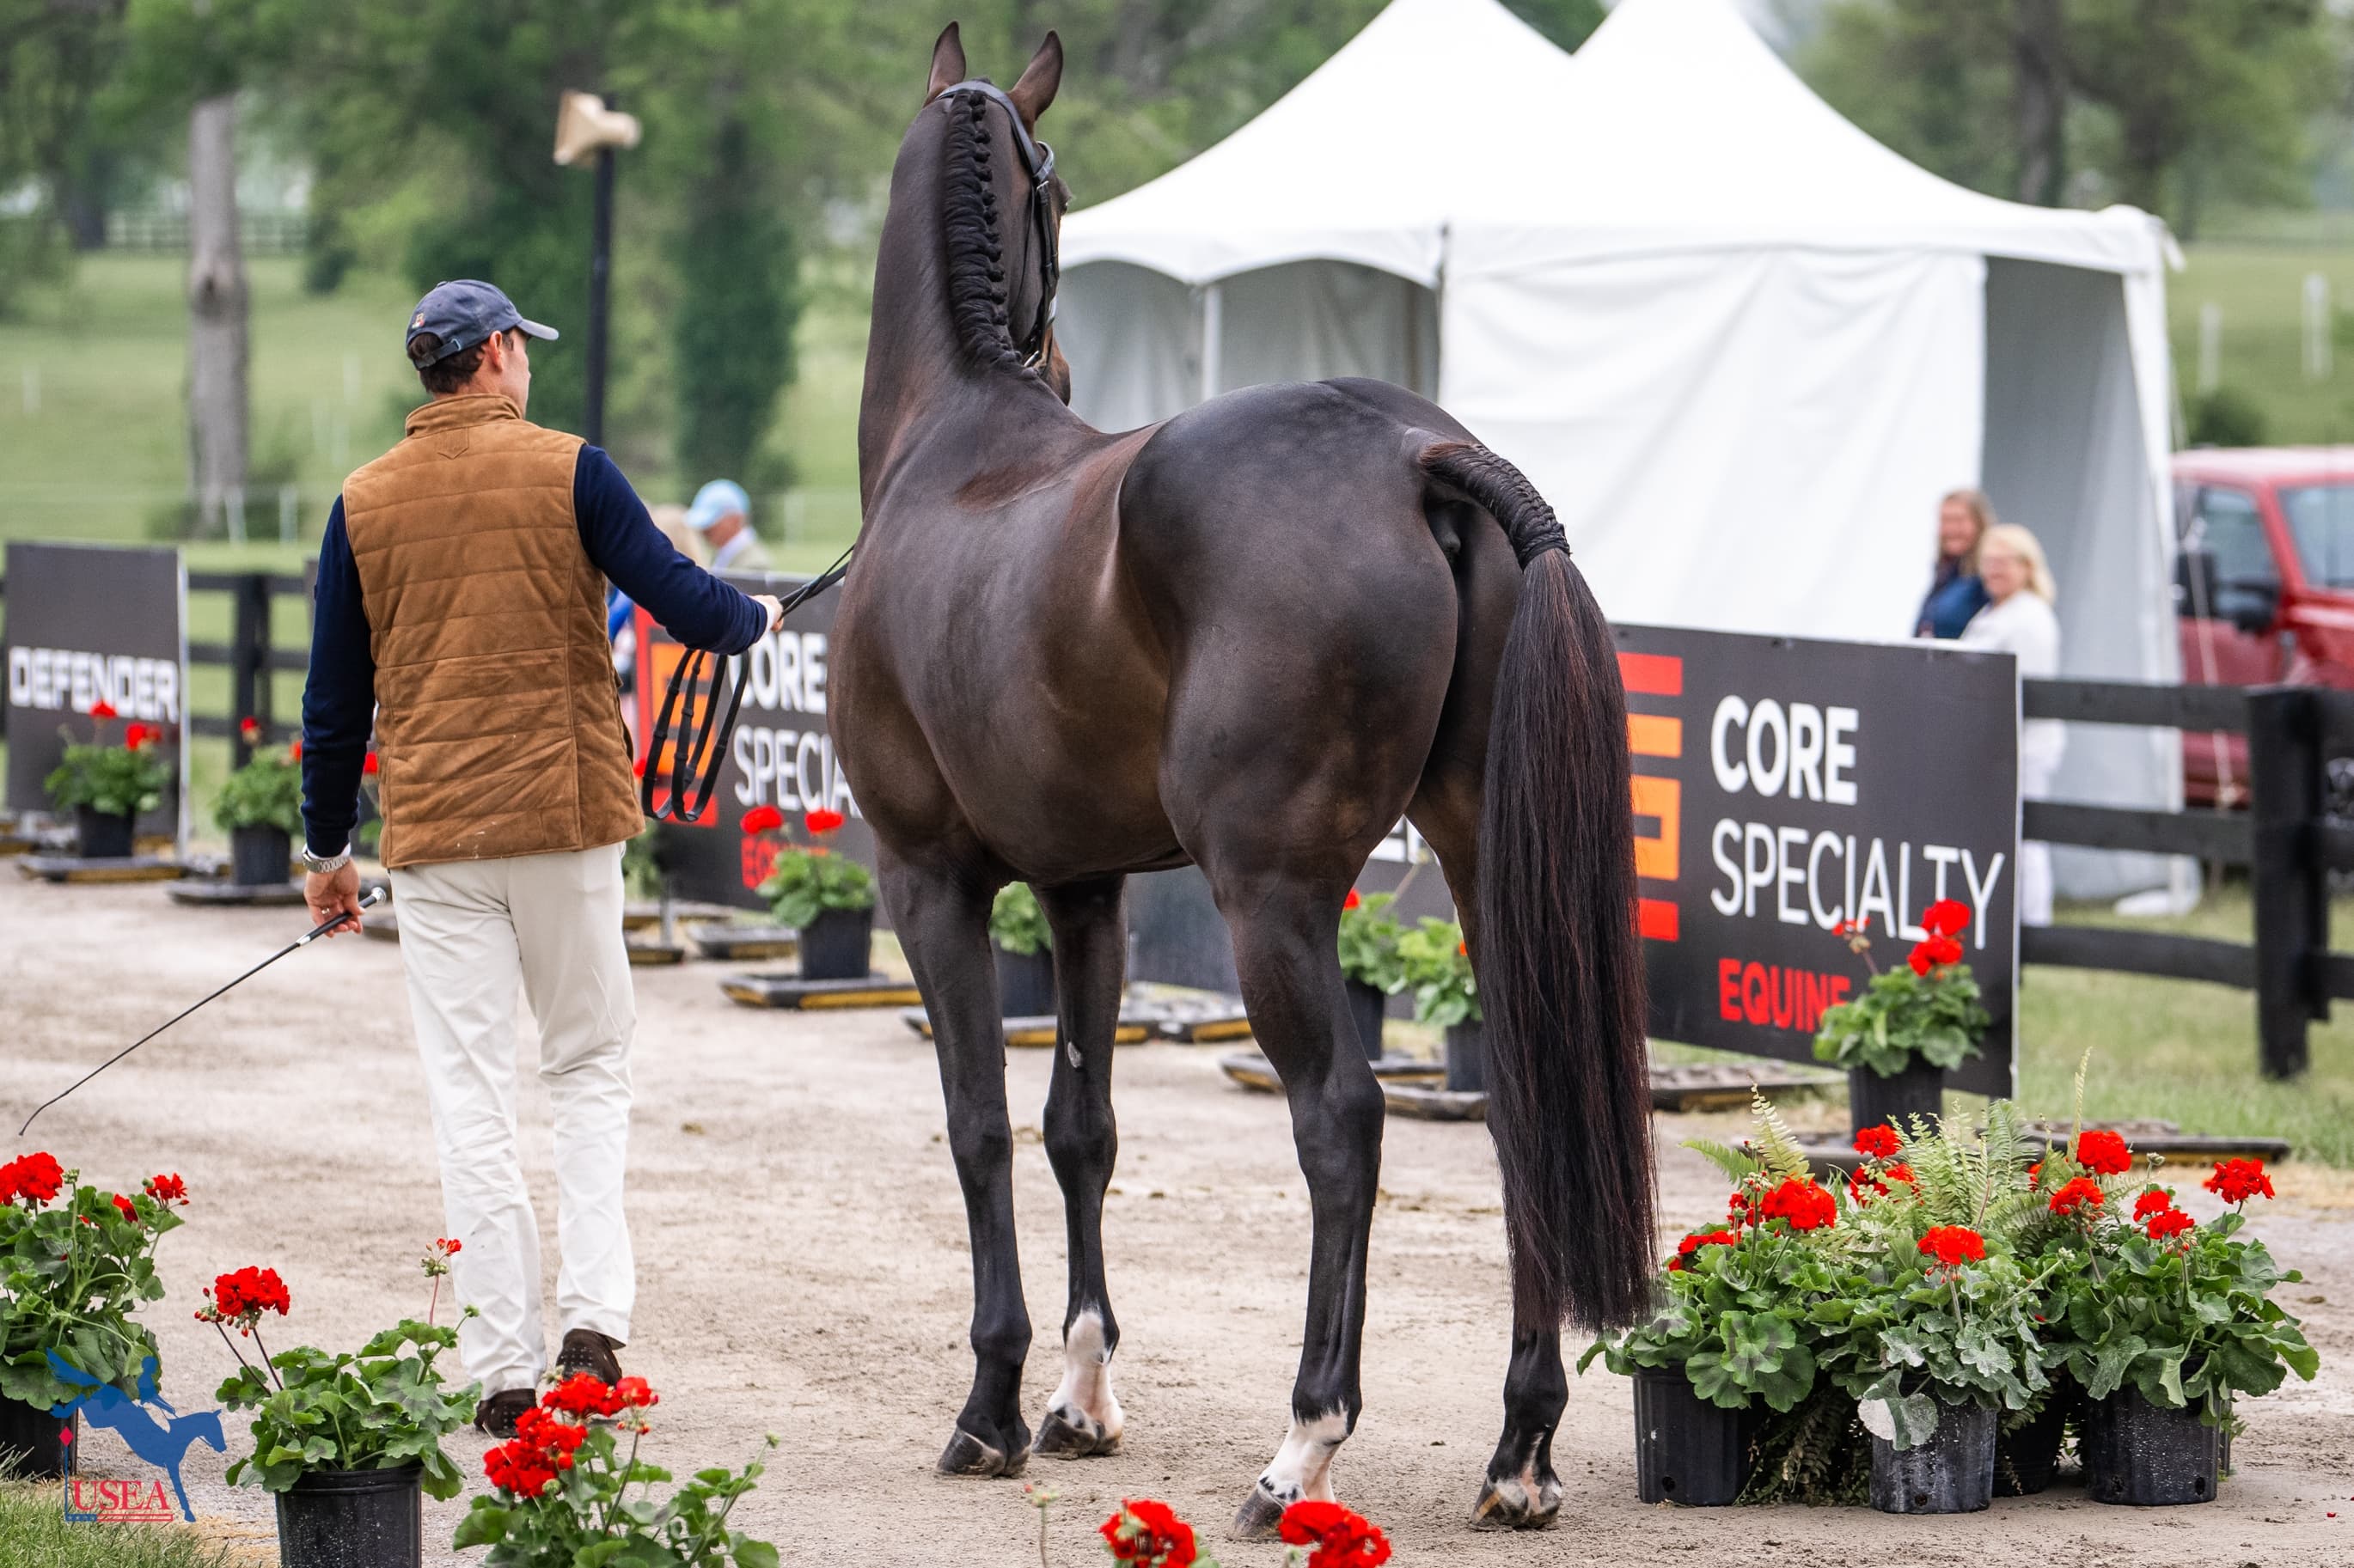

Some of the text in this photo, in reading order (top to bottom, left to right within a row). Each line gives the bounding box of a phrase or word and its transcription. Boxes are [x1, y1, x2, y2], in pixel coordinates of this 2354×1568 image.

[9, 646, 179, 723] DEFENDER
[734, 724, 862, 818] SPECIA
[1710, 694, 1859, 805] CORE
[1710, 817, 2005, 950] SPECIALTY
